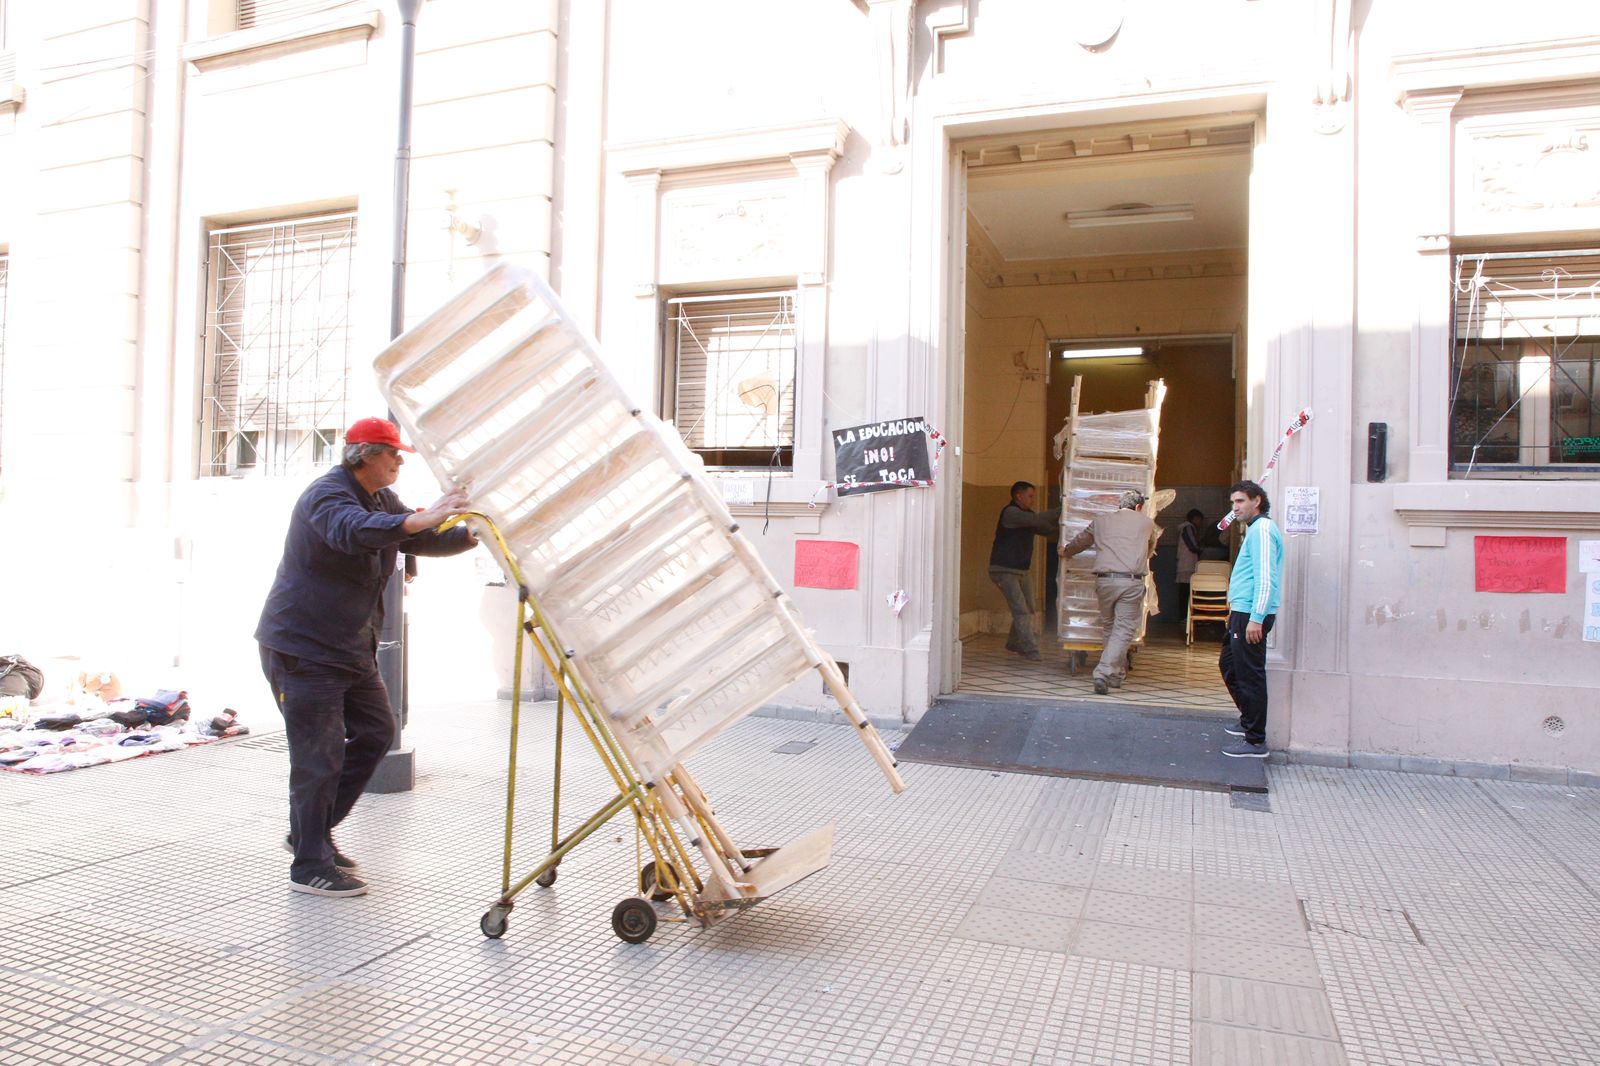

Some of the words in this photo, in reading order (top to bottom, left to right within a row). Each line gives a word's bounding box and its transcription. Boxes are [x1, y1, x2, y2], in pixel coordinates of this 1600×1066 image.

[837, 430, 855, 446] LA
[859, 420, 924, 440] EDUCACION
[844, 474, 858, 489] SE
[879, 467, 915, 483] TOCA
